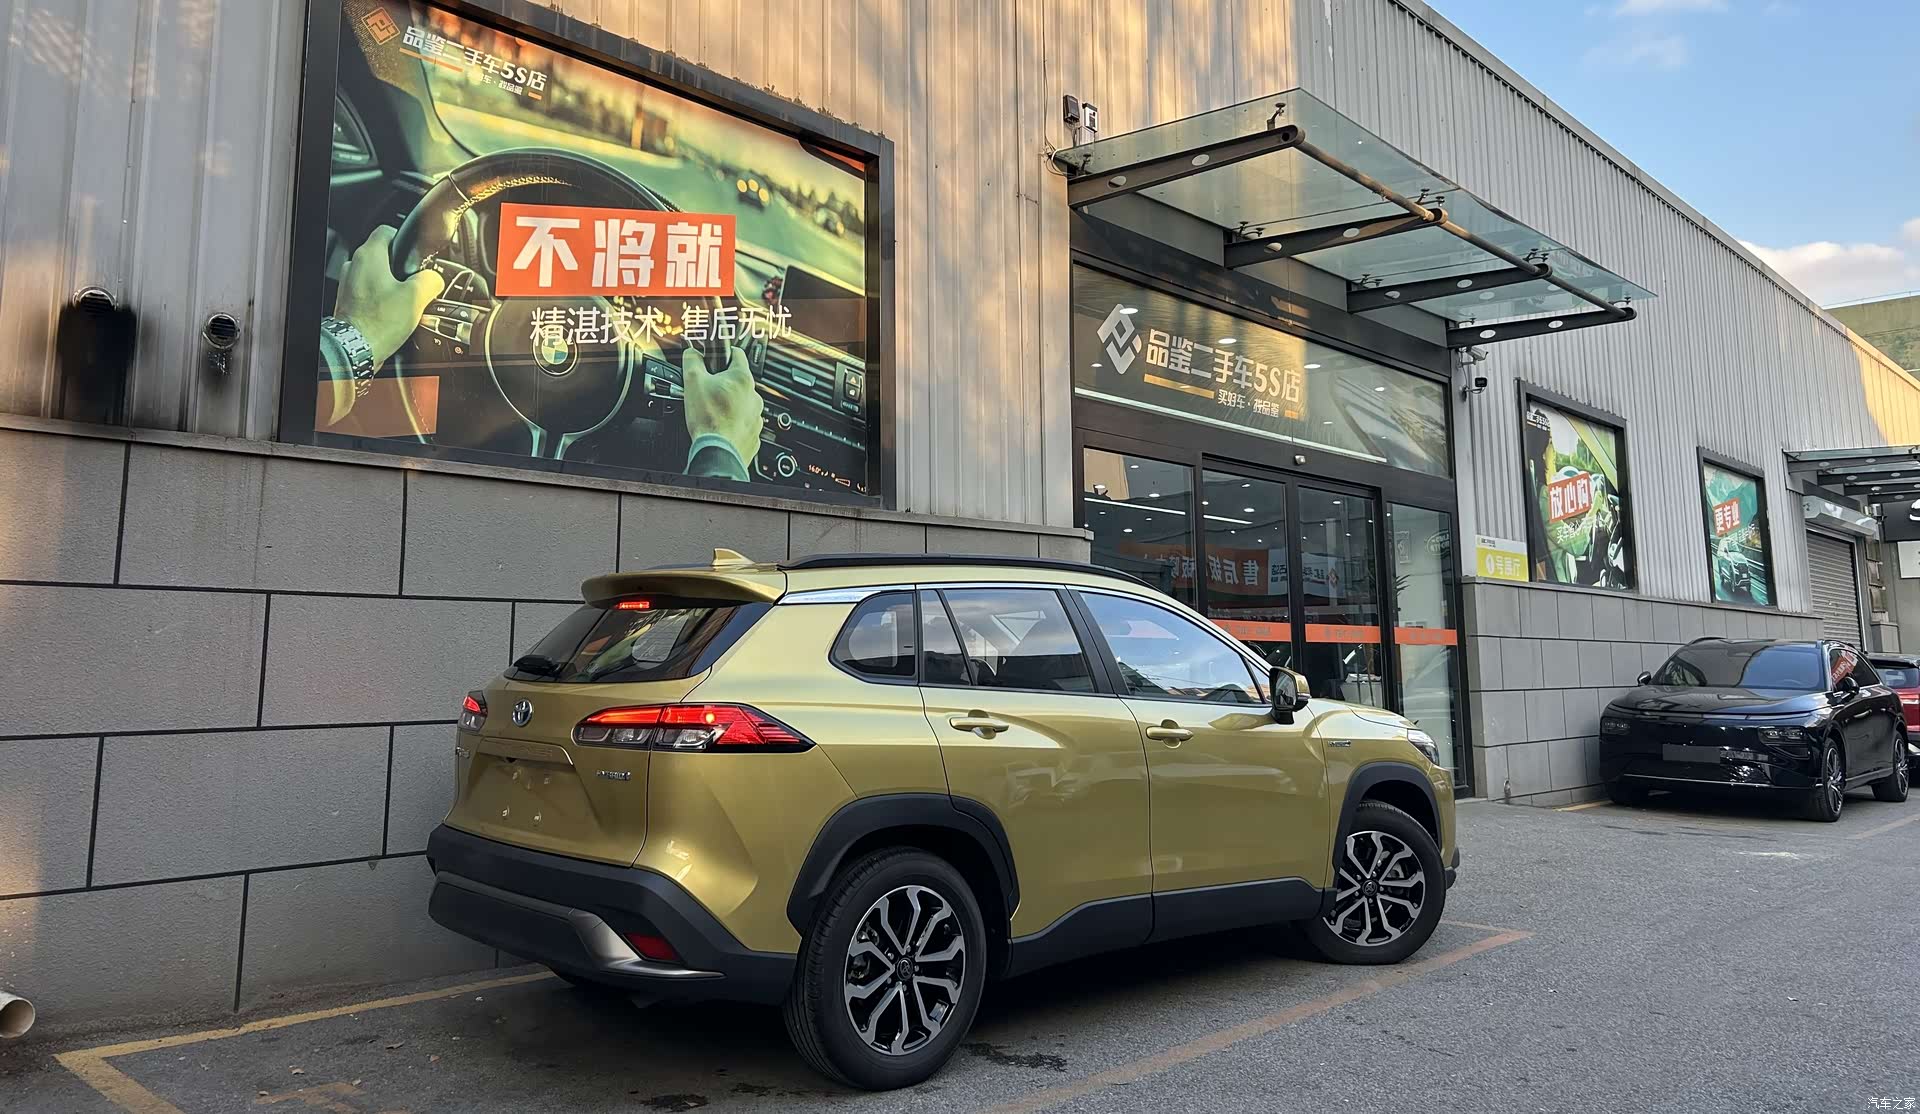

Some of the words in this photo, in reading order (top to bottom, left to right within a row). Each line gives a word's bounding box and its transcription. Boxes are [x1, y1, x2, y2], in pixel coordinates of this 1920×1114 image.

[402, 25, 548, 91] 品鉴二手车5S店
[512, 215, 723, 289] 不将就
[529, 305, 665, 347] 精湛技术
[680, 304, 793, 342] 售后无忧
[1145, 328, 1302, 403] 品鉴二手车5S店
[1549, 477, 1590, 520] 放心购
[1713, 501, 1740, 534] 更专业
